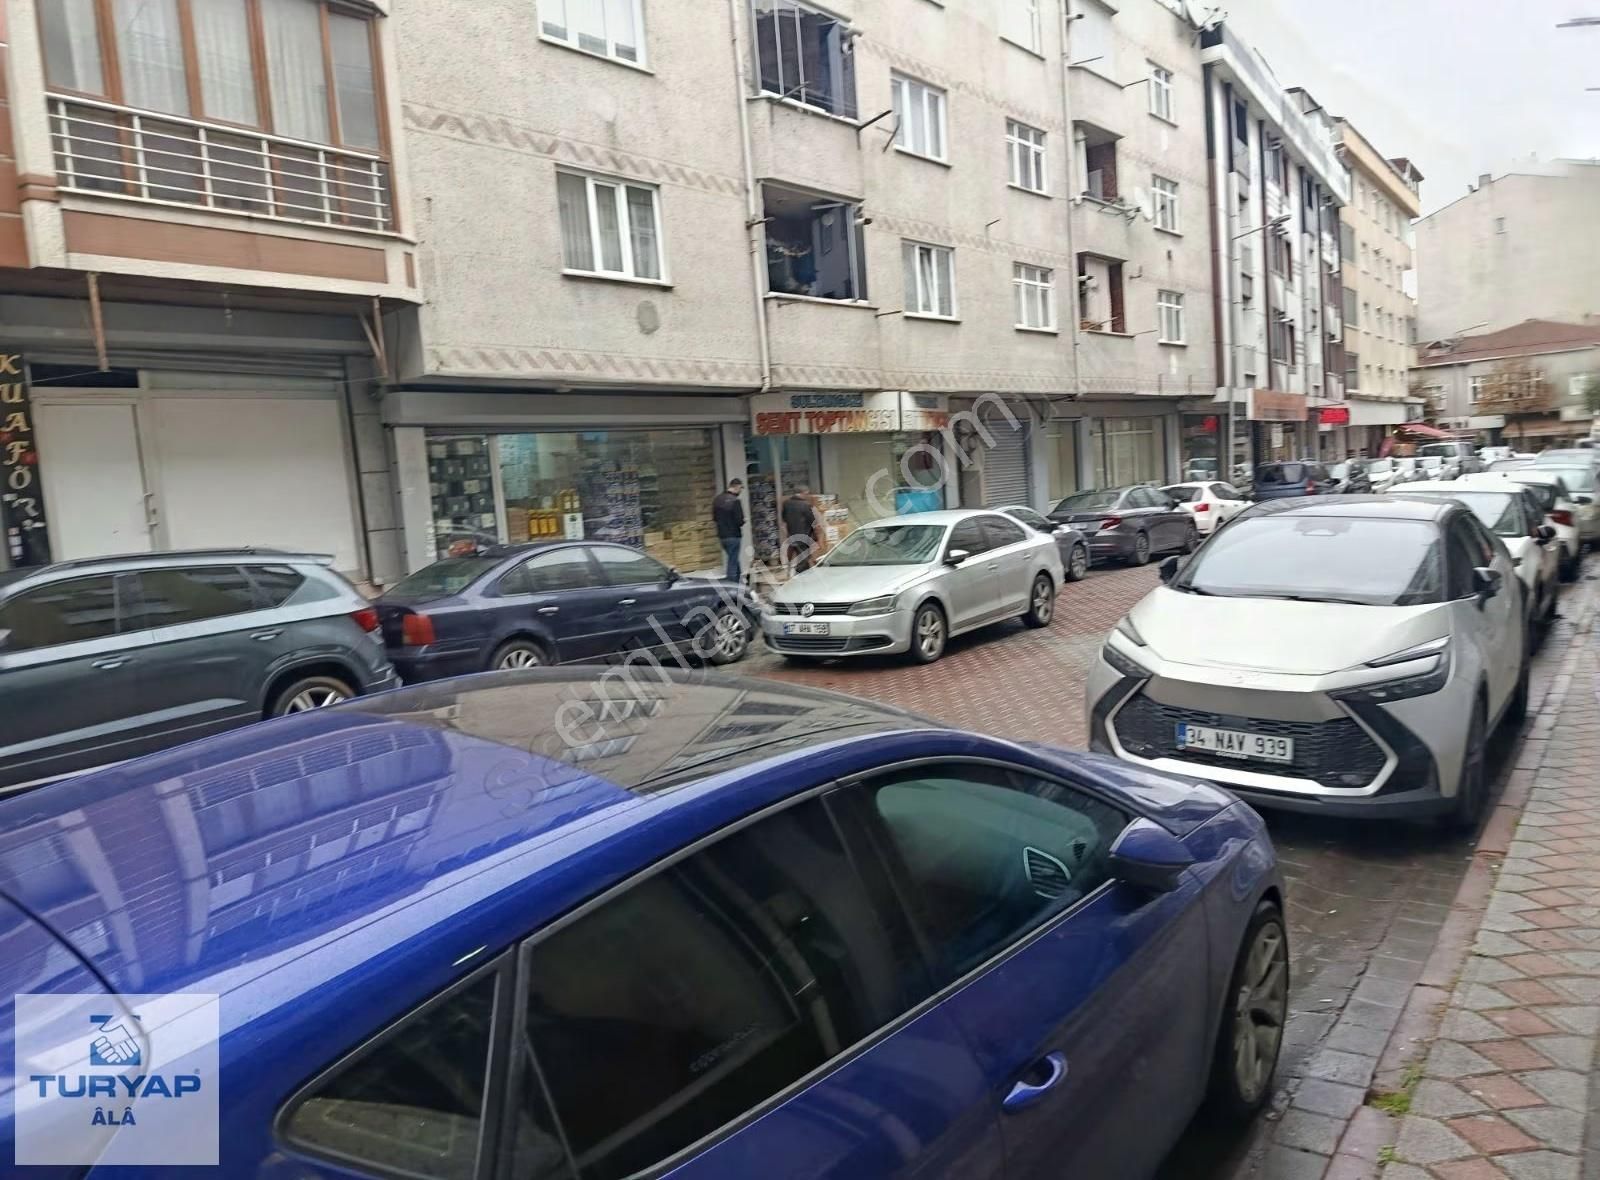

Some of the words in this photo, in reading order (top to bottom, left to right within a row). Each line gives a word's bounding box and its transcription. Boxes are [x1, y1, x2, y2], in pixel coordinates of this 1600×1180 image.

[1187, 728, 1205, 746] 34
[1215, 731, 1246, 751] NAV
[1255, 737, 1287, 756] 939
